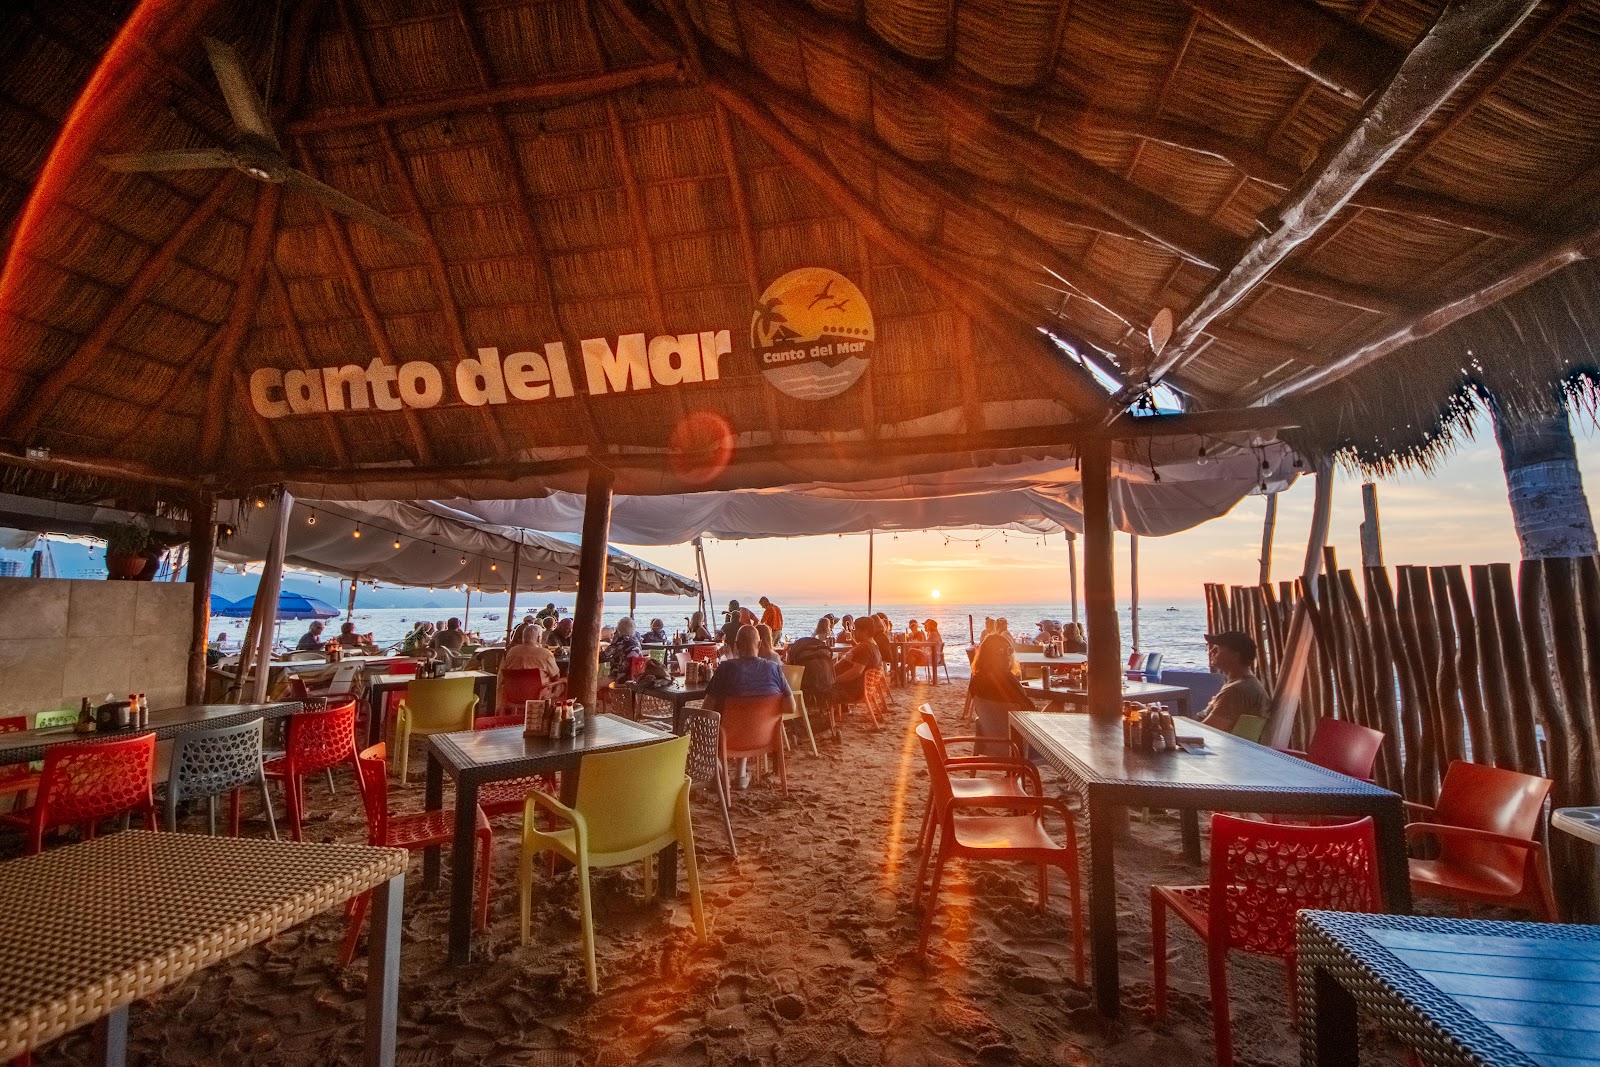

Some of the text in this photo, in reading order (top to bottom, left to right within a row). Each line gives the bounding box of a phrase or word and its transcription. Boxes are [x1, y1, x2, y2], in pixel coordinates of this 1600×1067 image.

[455, 341, 575, 407] del
[580, 329, 732, 396] Mar
[763, 341, 866, 363] Canto del Mar
